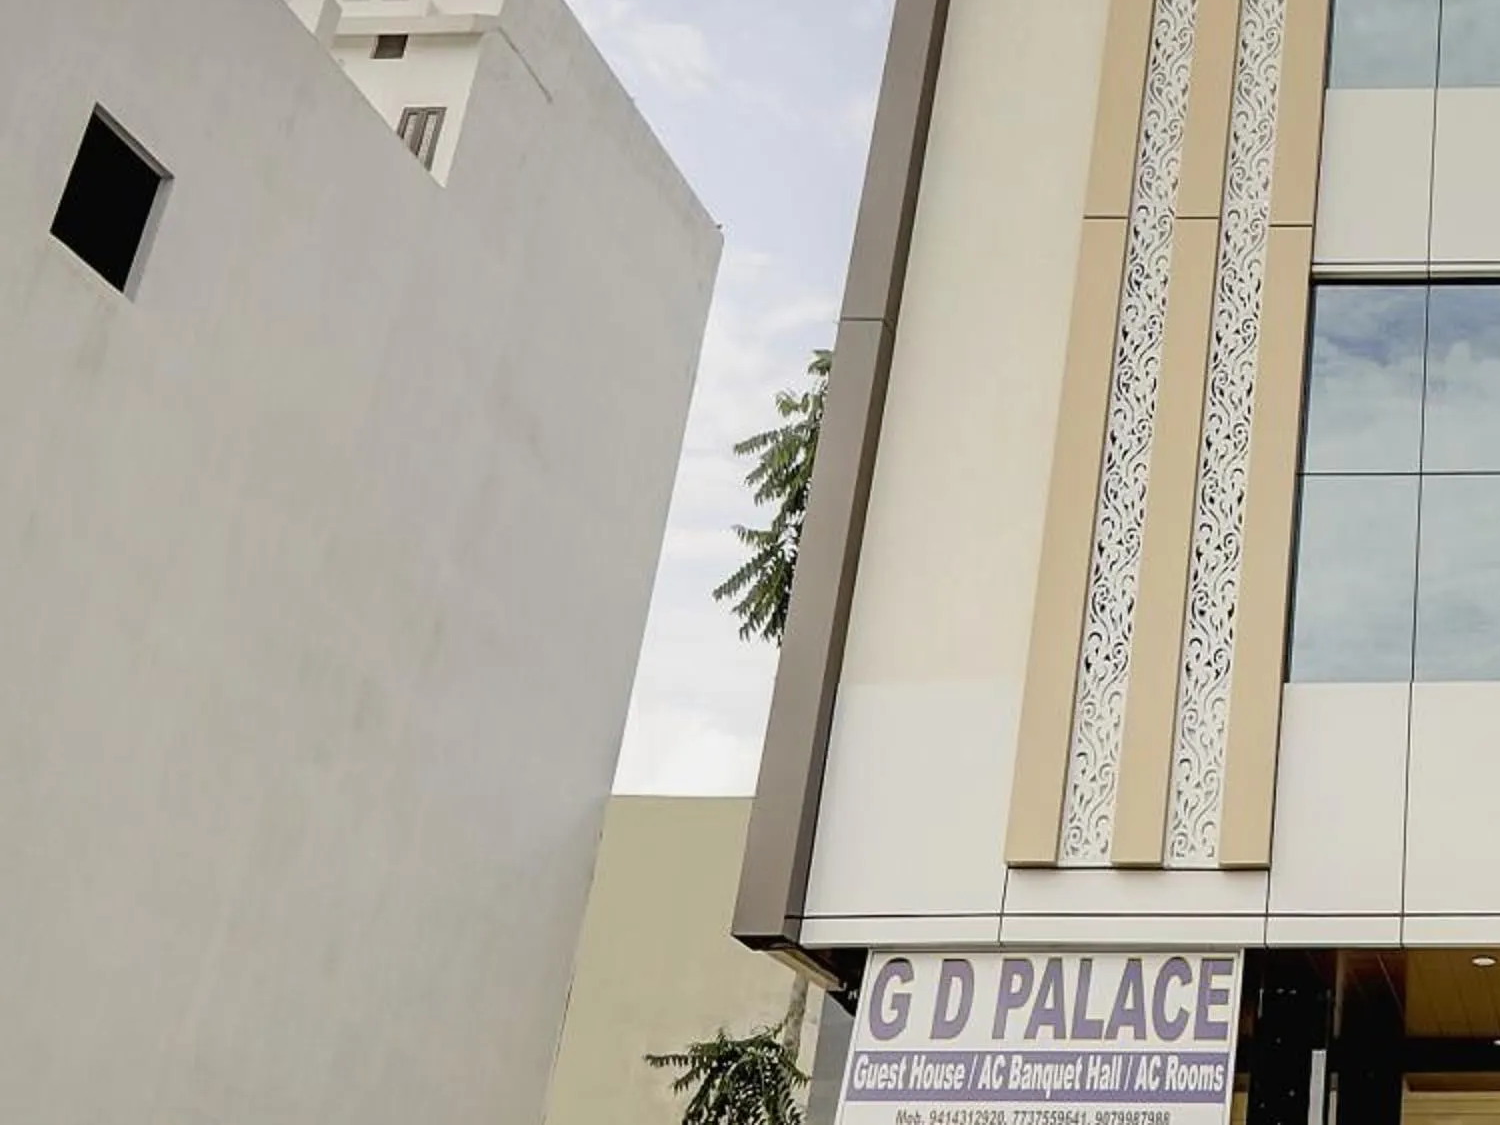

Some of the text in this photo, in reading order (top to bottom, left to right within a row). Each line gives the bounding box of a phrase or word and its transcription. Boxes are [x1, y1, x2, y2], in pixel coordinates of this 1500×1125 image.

[869, 956, 1235, 1042] G D PALACE
[853, 1054, 907, 1090] Guest
[908, 1055, 966, 1090] House
[978, 1054, 1006, 1090] AC
[1008, 1055, 1083, 1097] Banquet
[1086, 1054, 1123, 1090] Hall
[1134, 1055, 1162, 1090] AC
[1165, 1055, 1225, 1091] Rooms
